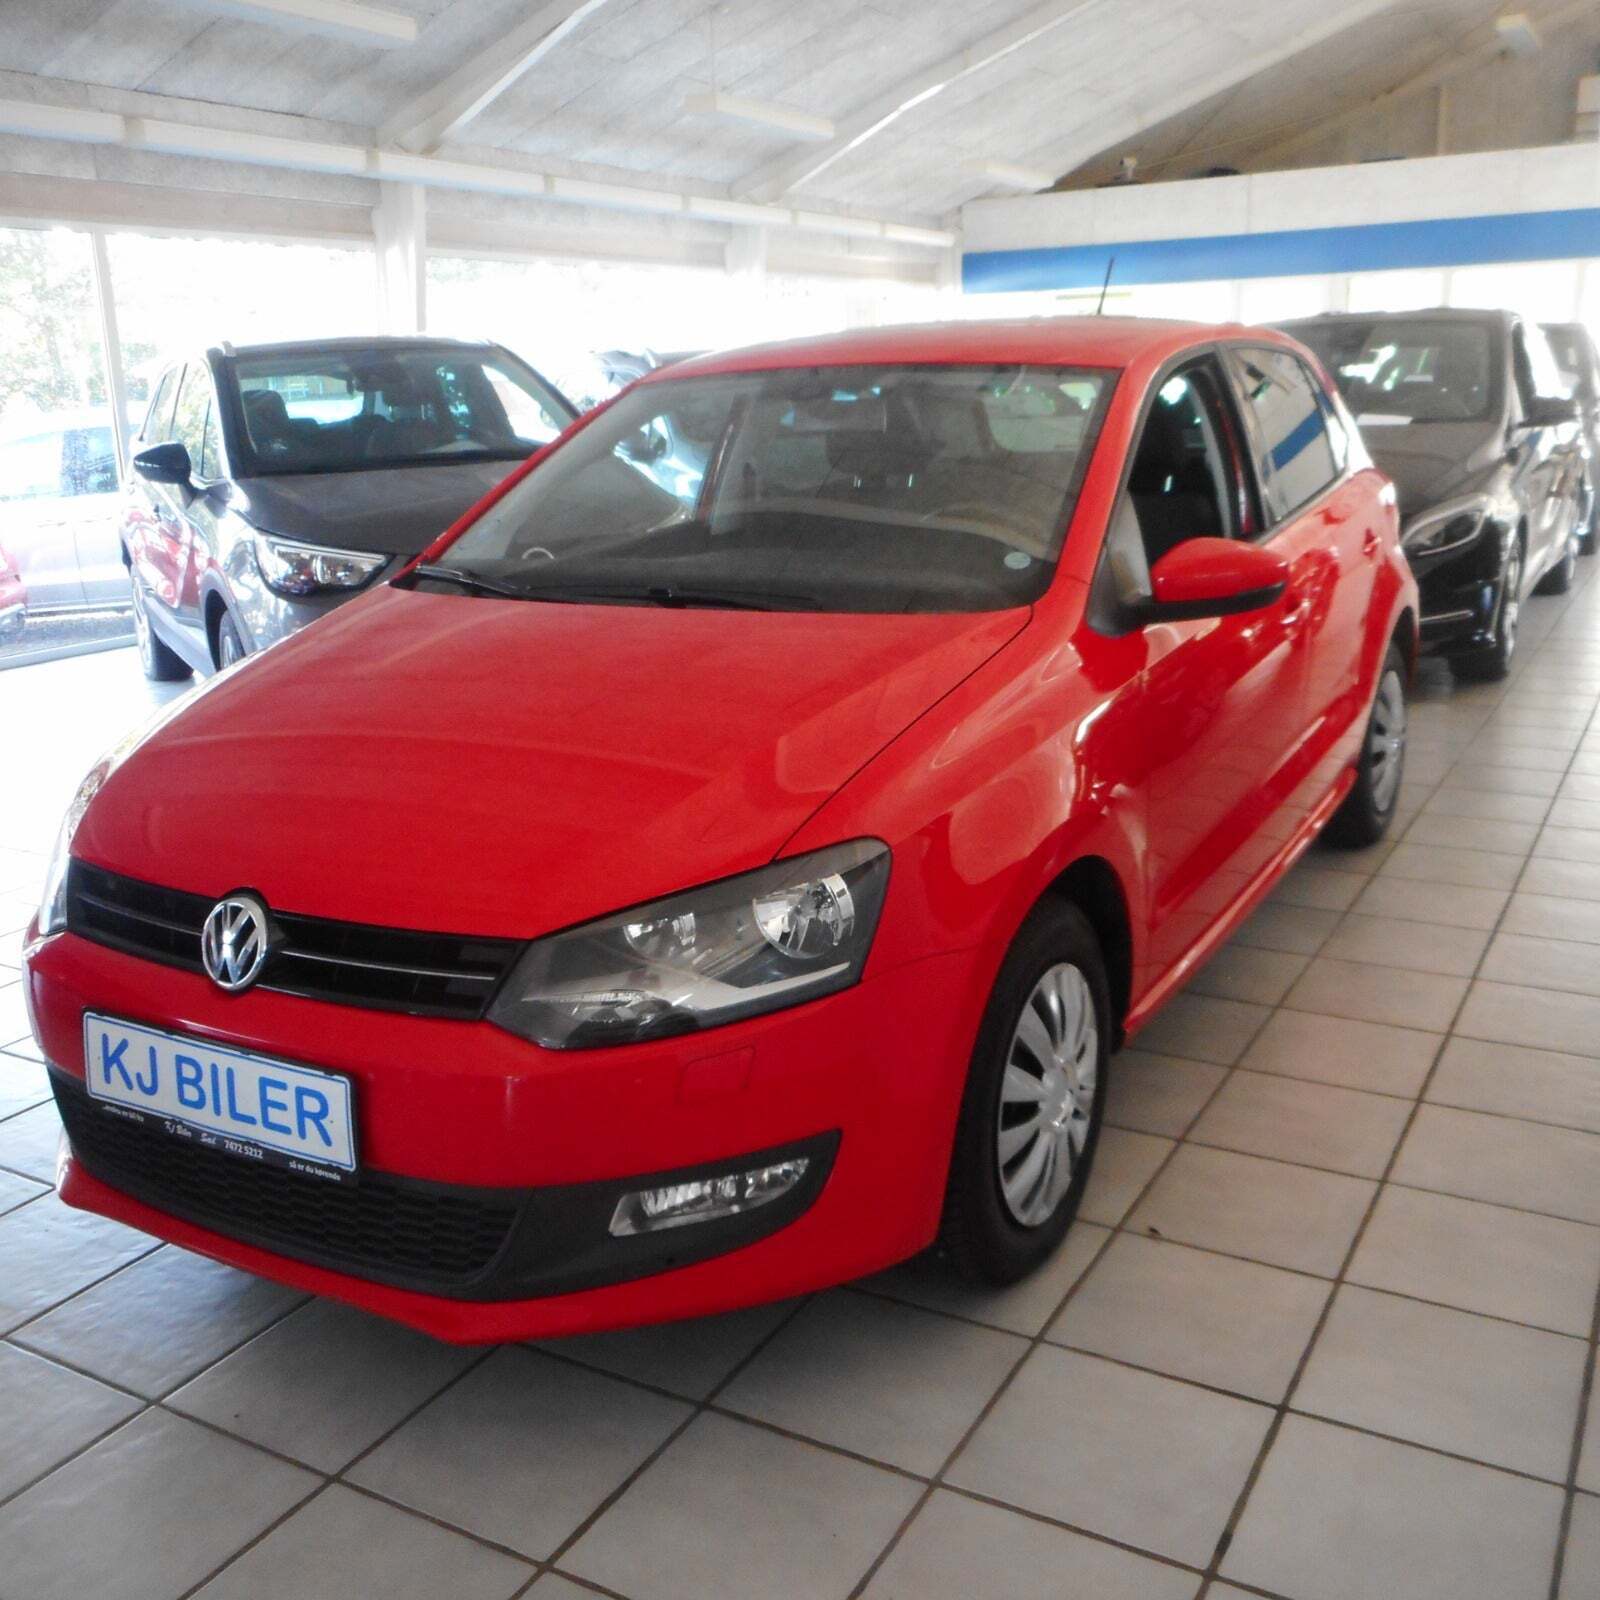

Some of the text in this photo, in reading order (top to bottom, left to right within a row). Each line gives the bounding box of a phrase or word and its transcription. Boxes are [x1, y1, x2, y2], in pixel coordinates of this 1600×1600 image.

[102, 1033, 333, 1147] KJ BILER
[224, 1139, 243, 1153] 7472
[244, 1145, 263, 1159] 5212
